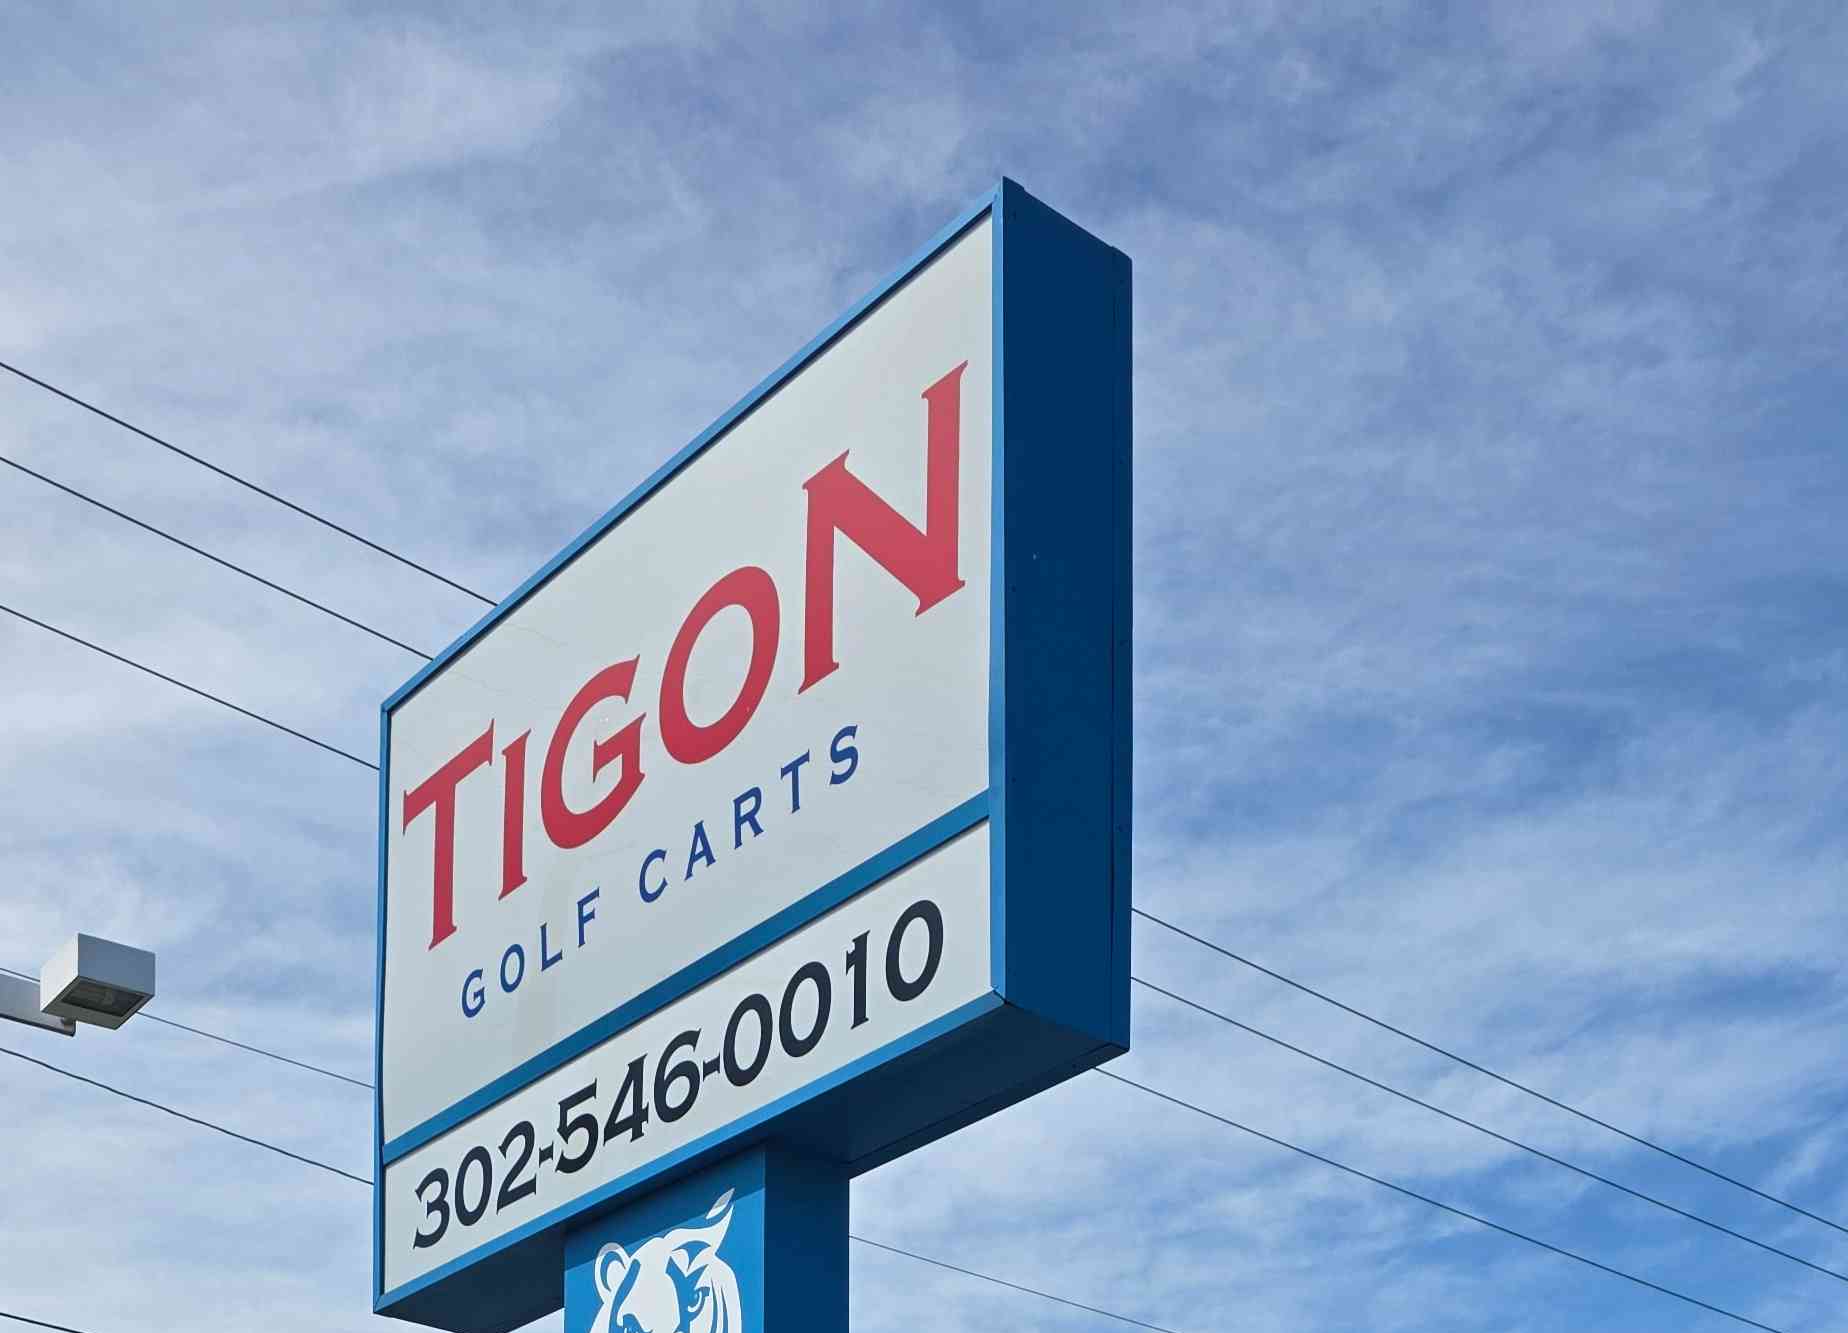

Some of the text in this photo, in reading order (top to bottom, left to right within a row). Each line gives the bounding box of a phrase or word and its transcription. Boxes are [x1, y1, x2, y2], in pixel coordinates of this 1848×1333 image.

[403, 361, 967, 950] TIGON
[460, 724, 861, 1018] GOLF CARTS
[412, 898, 945, 1250] 302-546-0010
